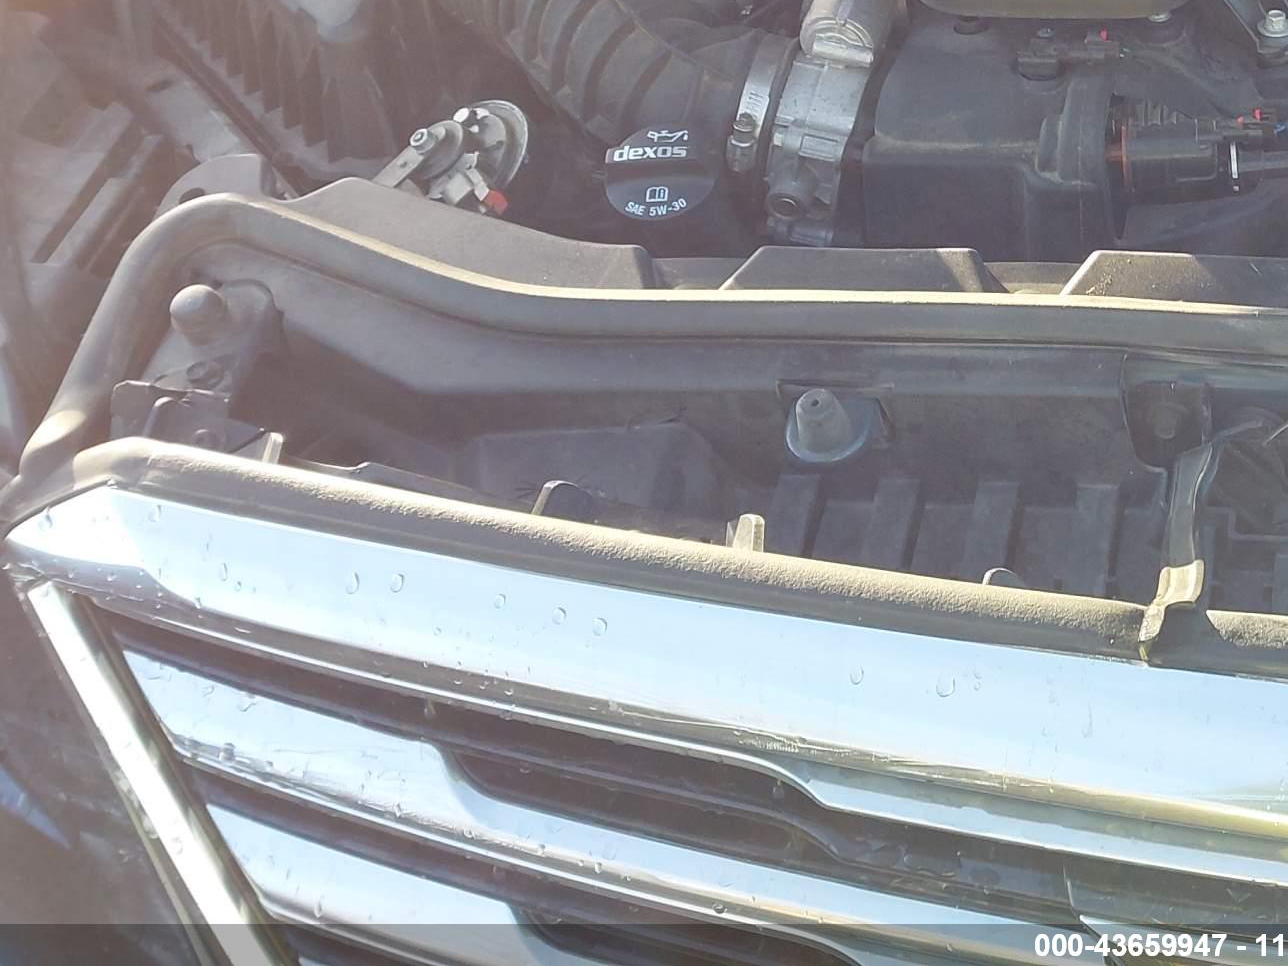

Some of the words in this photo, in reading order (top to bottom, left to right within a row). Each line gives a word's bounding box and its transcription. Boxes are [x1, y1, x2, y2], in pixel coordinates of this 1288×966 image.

[613, 145, 688, 162] dexos
[624, 201, 646, 216] SAE
[648, 197, 688, 217] 5W-30
